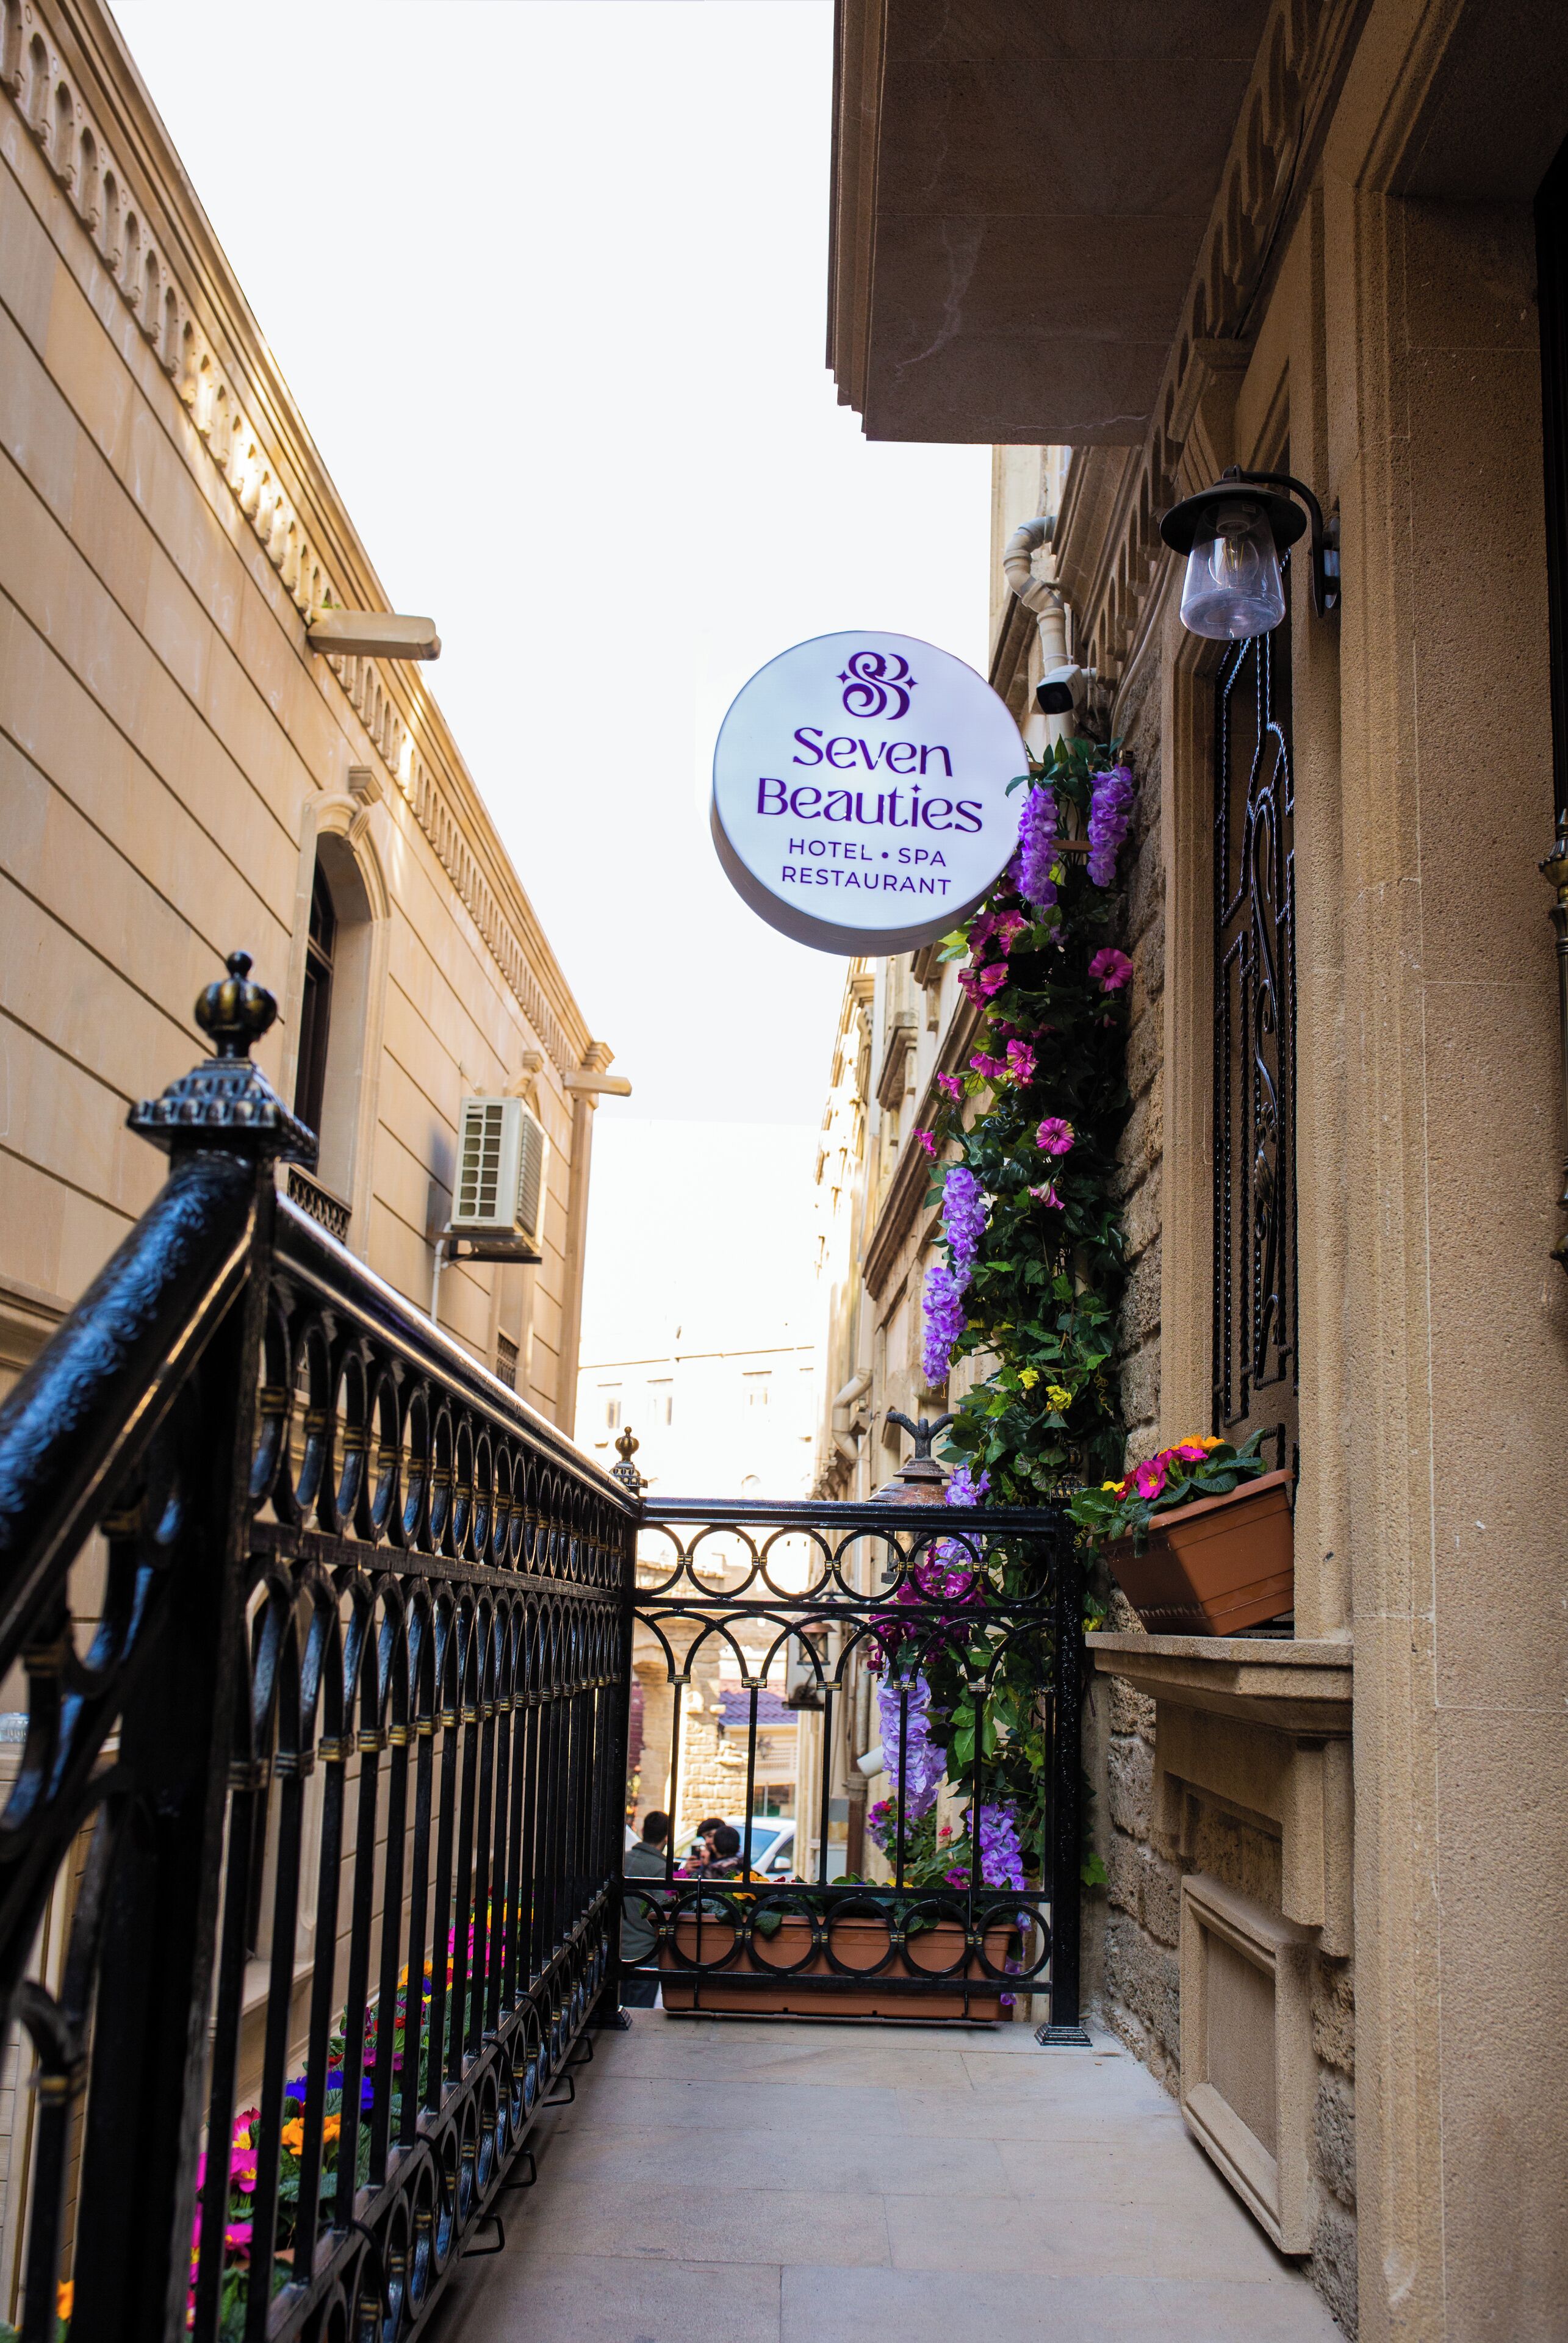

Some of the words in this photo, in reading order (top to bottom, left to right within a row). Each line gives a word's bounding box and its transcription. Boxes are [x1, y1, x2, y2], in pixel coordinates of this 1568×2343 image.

[793, 726, 954, 778] Seven
[757, 777, 984, 833] Beauties
[788, 837, 874, 862] HOTEL
[897, 847, 947, 868] SPA
[781, 865, 952, 896] RESTAURANT
